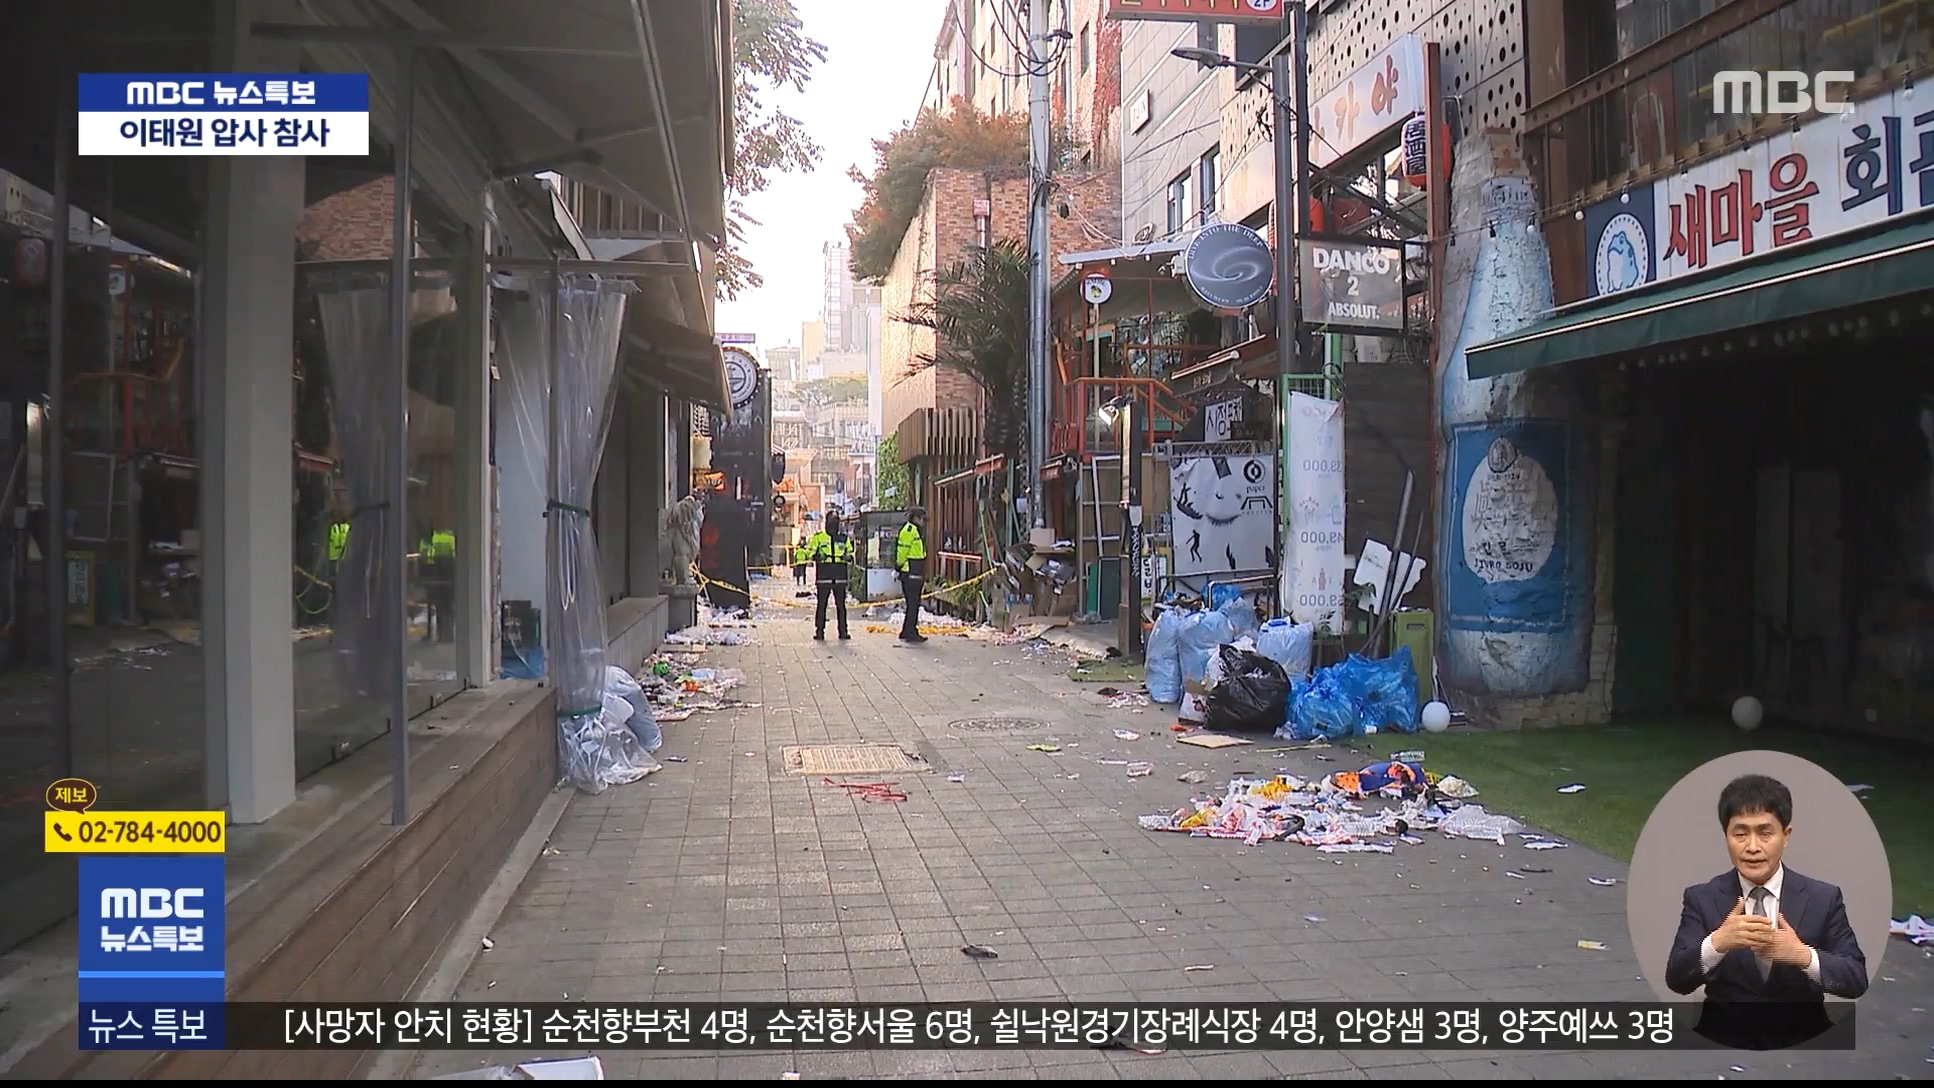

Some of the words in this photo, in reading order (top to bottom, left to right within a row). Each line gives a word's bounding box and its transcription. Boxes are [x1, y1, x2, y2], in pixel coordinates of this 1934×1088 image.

[1663, 153, 1819, 268] 새마을
[1200, 225, 1219, 241] INTO
[1223, 225, 1240, 233] THE
[1242, 228, 1263, 247] DEEP
[1313, 247, 1390, 275] DANCO
[1347, 276, 1359, 296] 2
